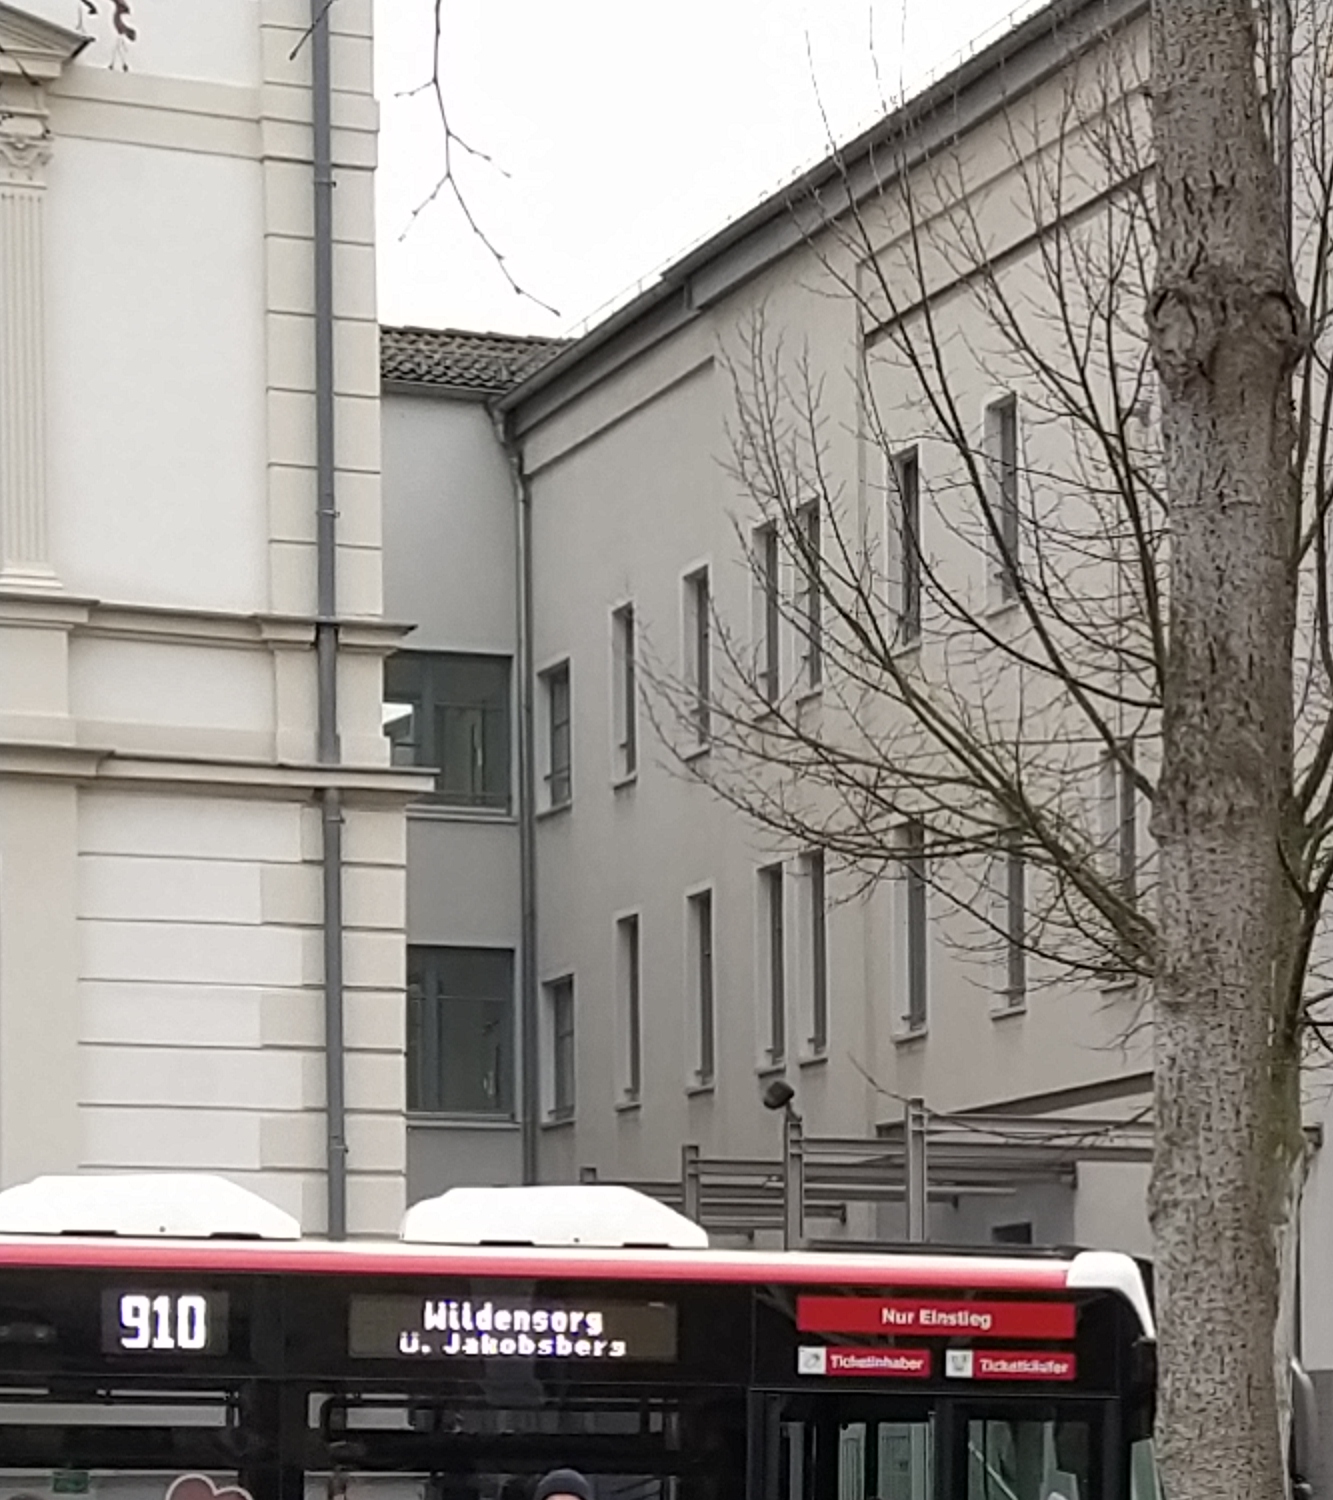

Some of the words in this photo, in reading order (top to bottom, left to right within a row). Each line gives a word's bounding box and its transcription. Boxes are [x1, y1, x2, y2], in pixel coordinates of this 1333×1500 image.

[120, 1295, 206, 1349] 910
[424, 1301, 603, 1335] Wildensorg
[881, 1308, 913, 1325] Nur
[919, 1309, 992, 1329] Einstieg
[443, 1333, 627, 1357] Jakobsberg
